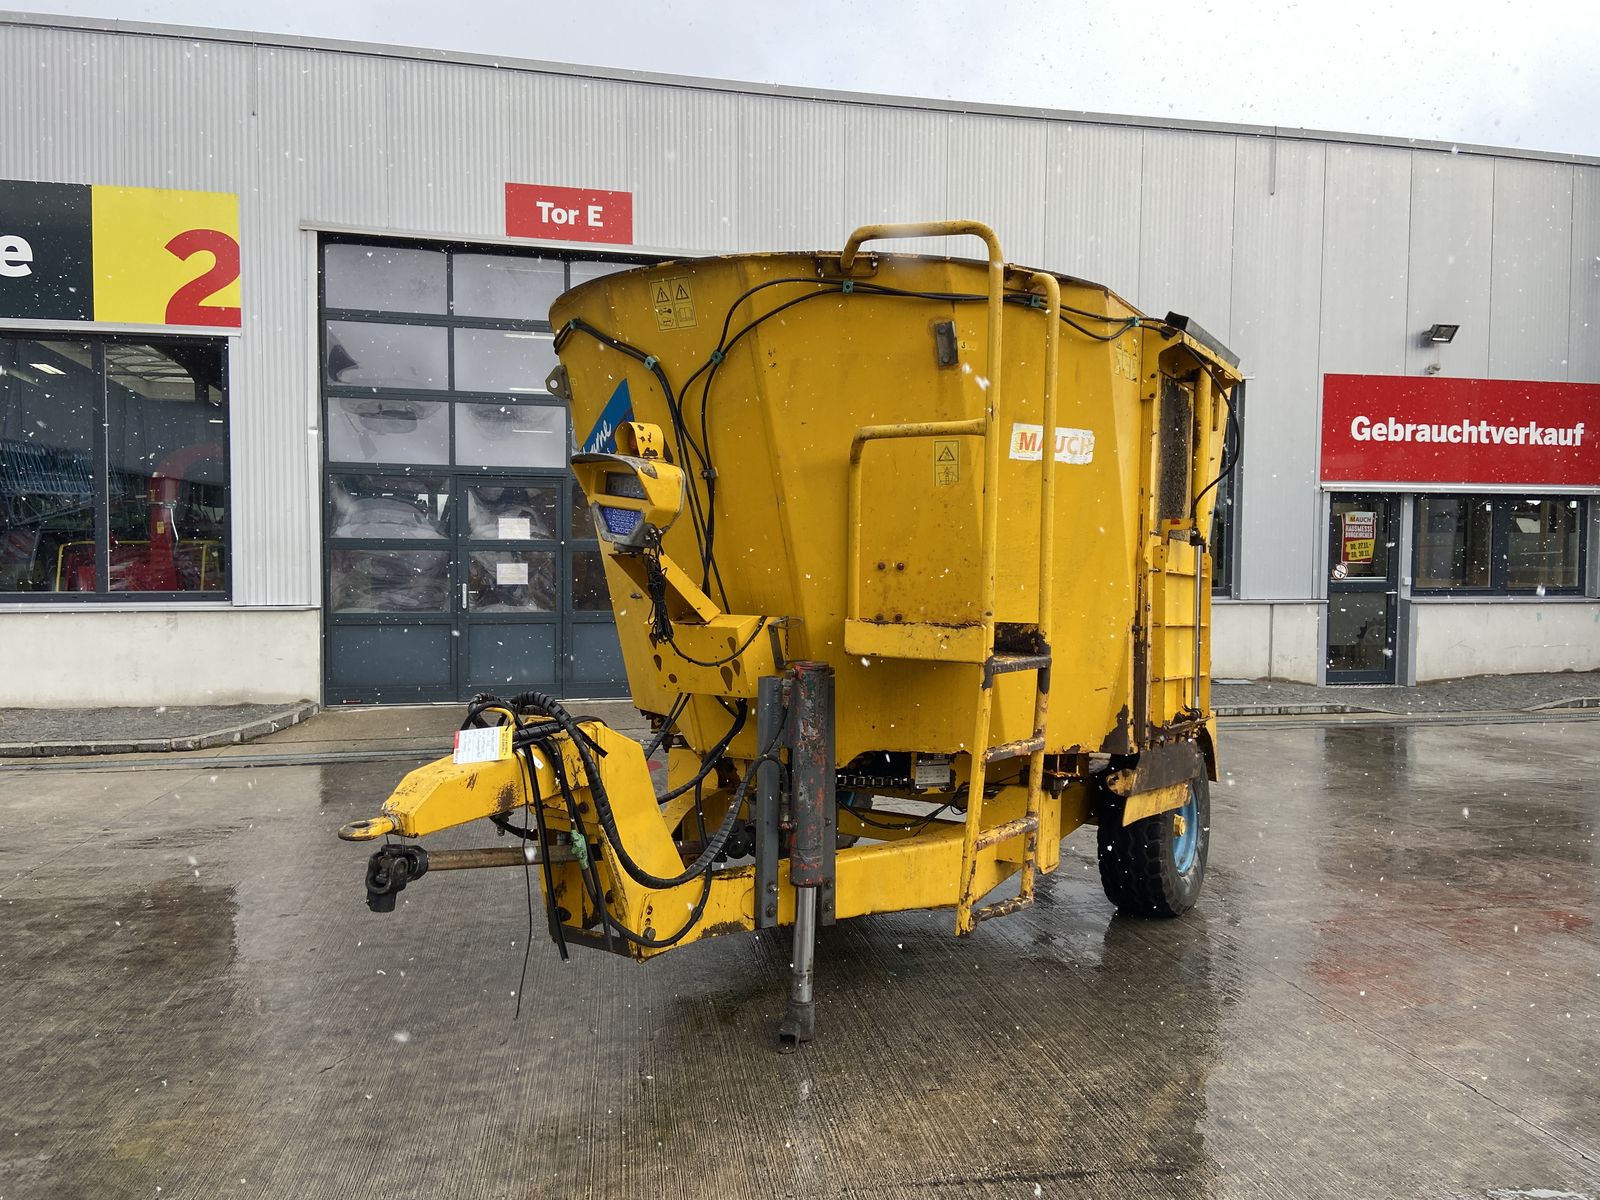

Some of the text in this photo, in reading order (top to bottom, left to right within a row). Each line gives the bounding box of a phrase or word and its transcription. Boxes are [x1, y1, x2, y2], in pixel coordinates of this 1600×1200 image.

[536, 201, 604, 227] Tor E
[164, 229, 241, 328] 2
[1018, 431, 1093, 456] MUCH
[1350, 415, 1585, 446] Gebrauchtverkauf
